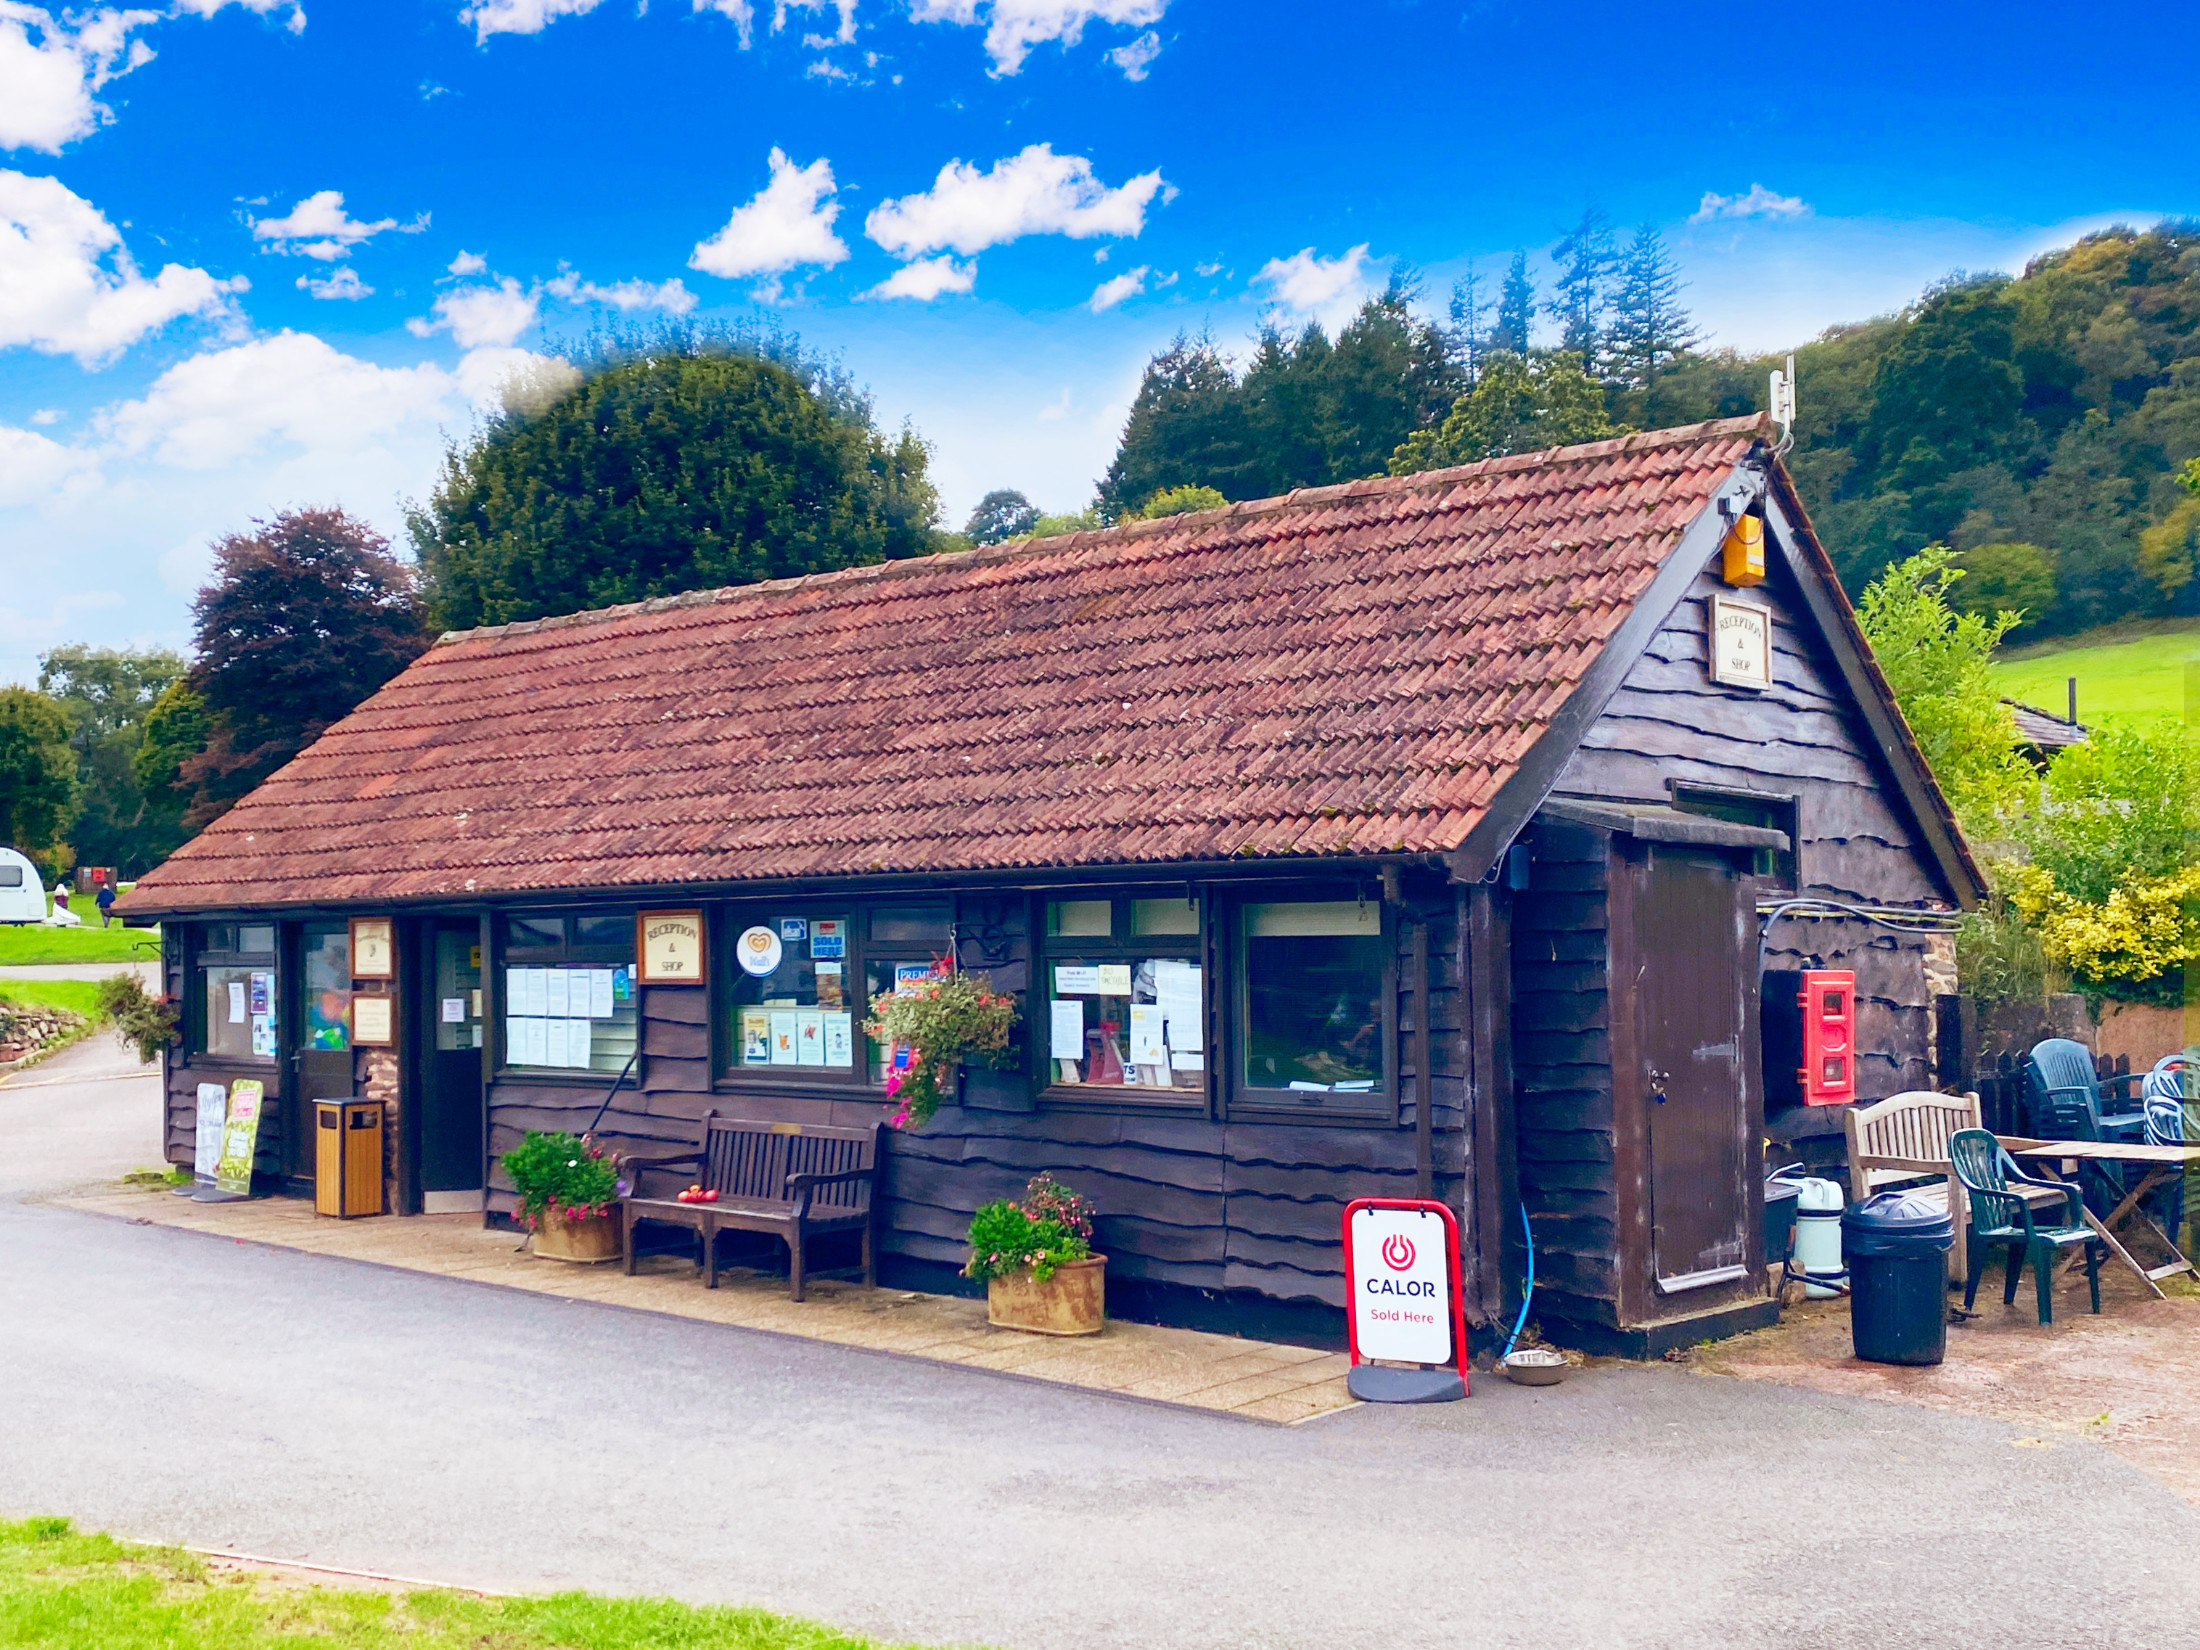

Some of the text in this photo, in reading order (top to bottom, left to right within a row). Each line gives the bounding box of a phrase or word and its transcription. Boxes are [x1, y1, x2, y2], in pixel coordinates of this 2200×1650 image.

[1719, 615, 1762, 638] RECEPTION
[1737, 638, 1744, 649] &
[1731, 658, 1751, 672] SHOP
[647, 923, 697, 941] RECEPTION
[813, 936, 843, 946] SOLD
[668, 942, 676, 953] &
[813, 946, 843, 957] HERE
[662, 961, 684, 972] SHOP
[1366, 1278, 1436, 1298] CALOR
[1370, 1309, 1435, 1324] Sold Here
